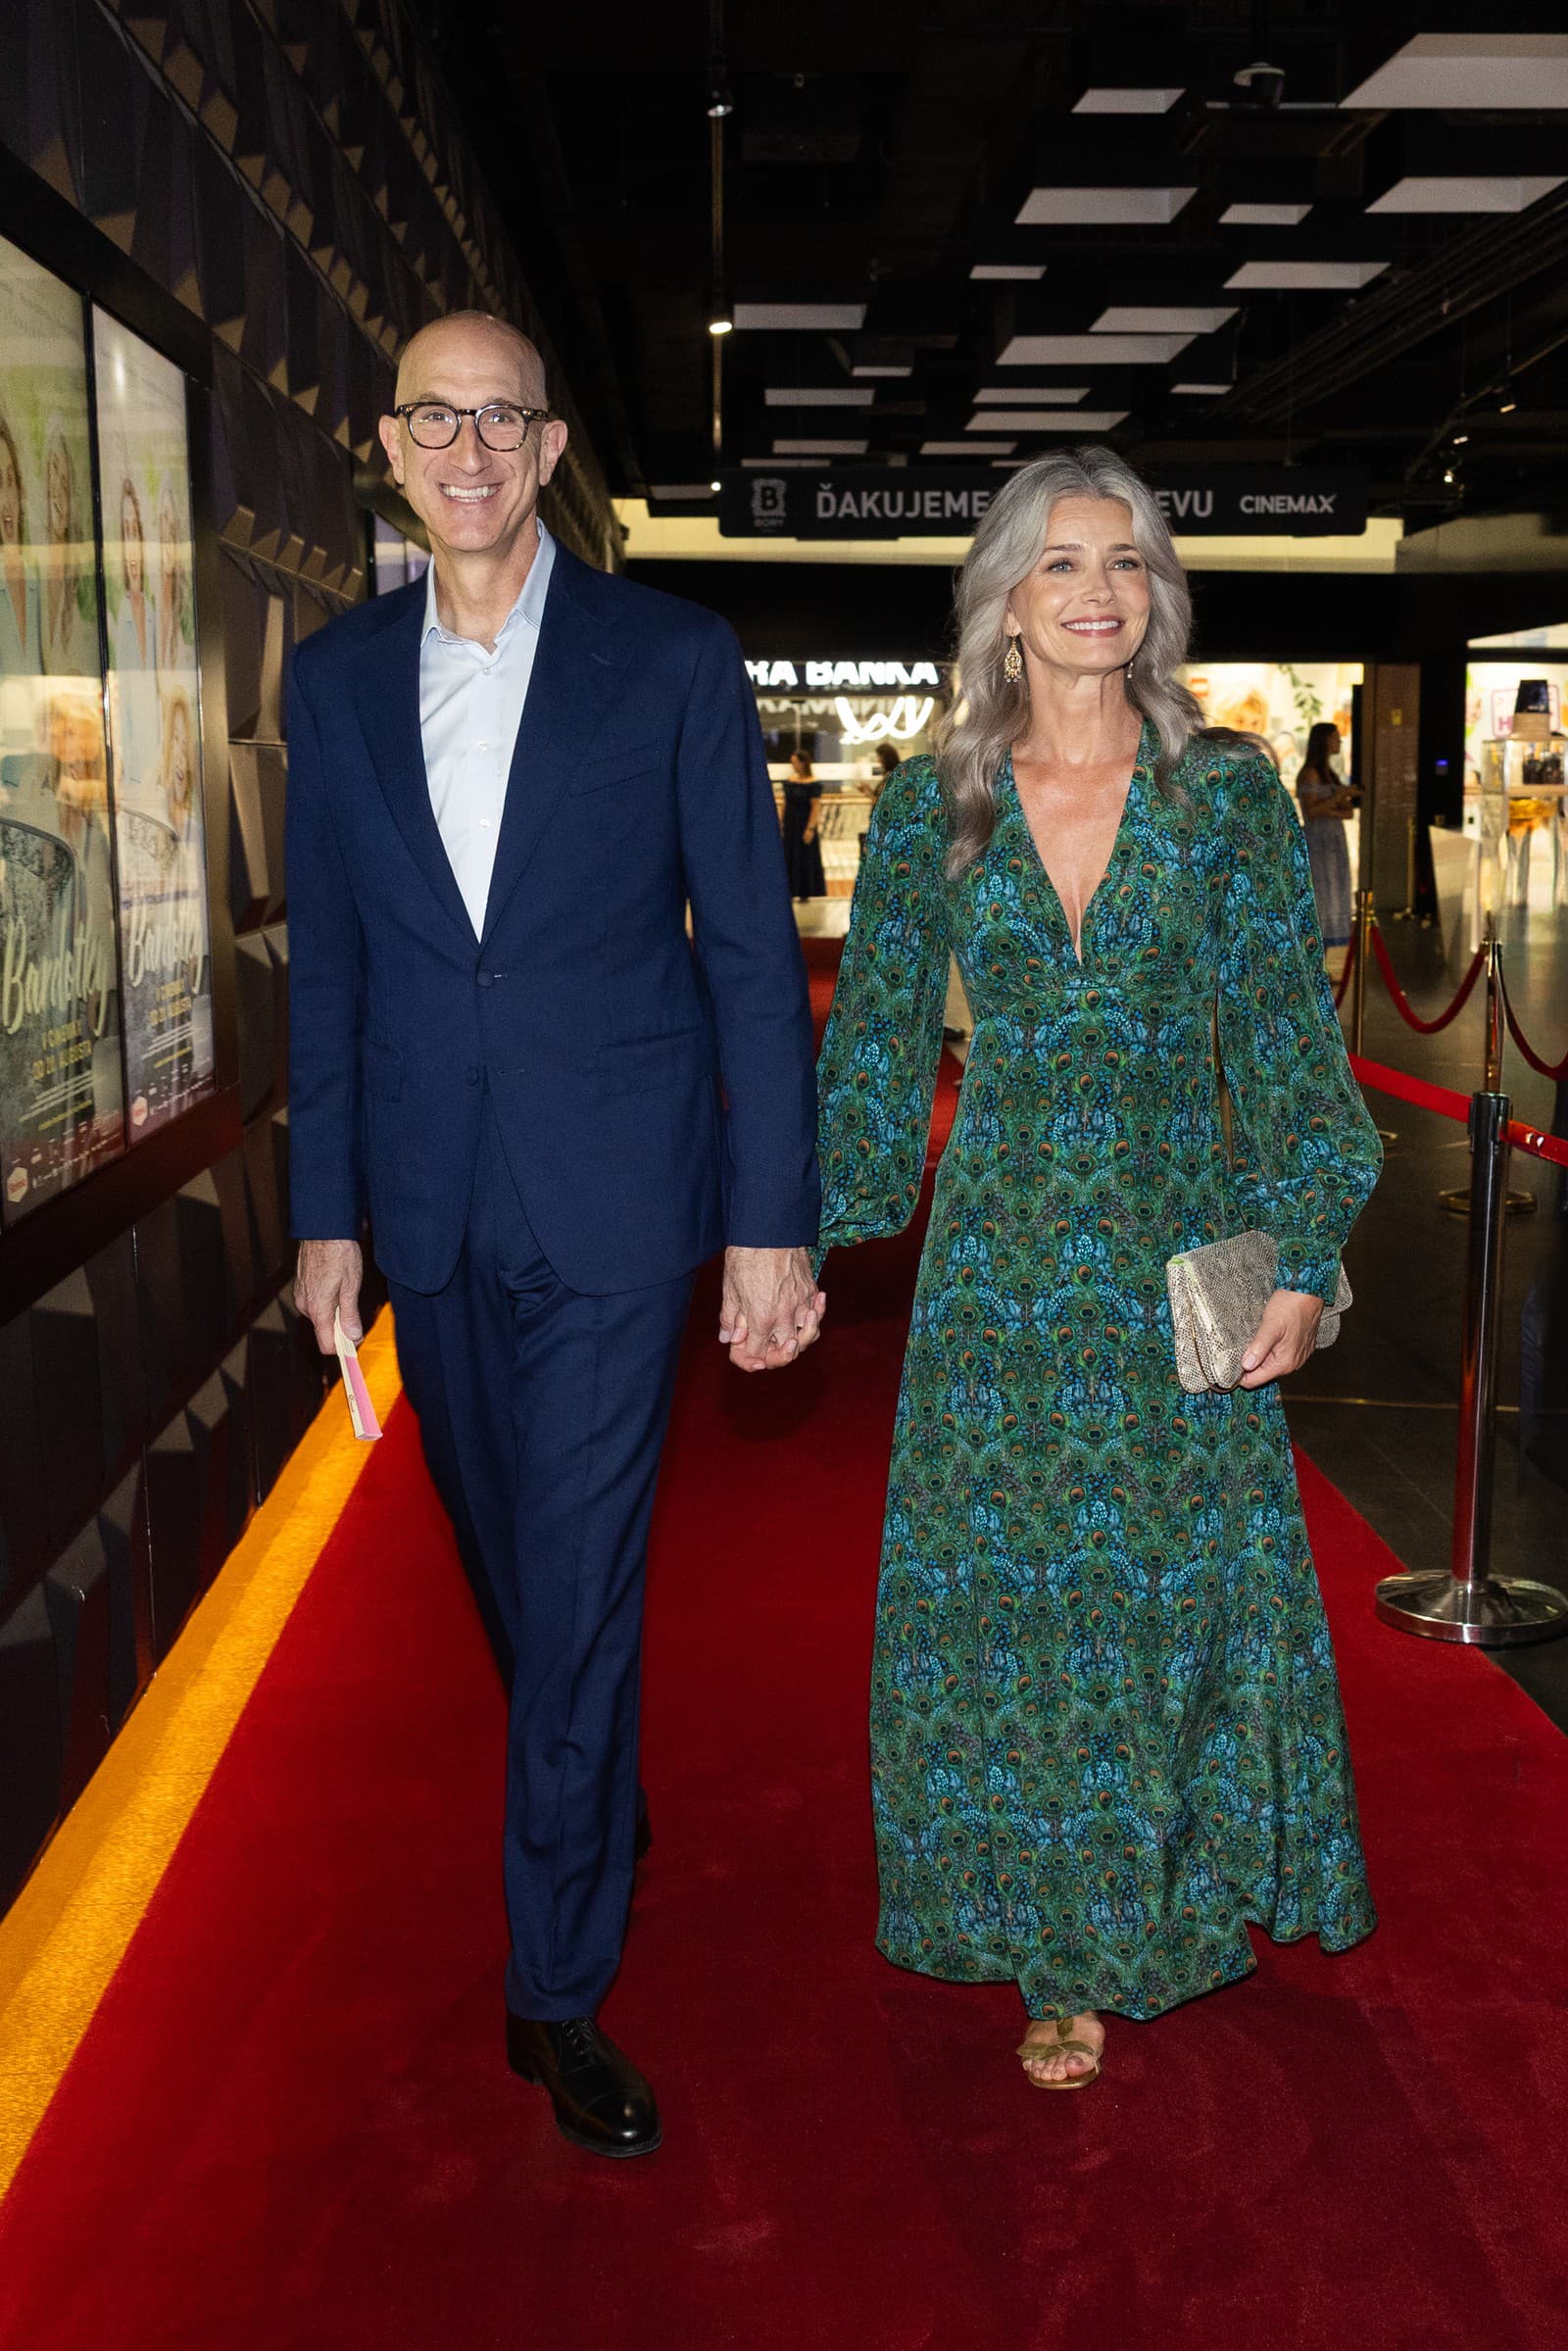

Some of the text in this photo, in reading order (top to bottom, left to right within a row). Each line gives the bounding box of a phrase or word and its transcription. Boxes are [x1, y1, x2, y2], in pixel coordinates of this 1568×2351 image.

[815, 481, 1214, 518] ĎAKUJEME EVU
[1239, 493, 1338, 515] CINEMAX
[806, 661, 939, 686] BANKA
